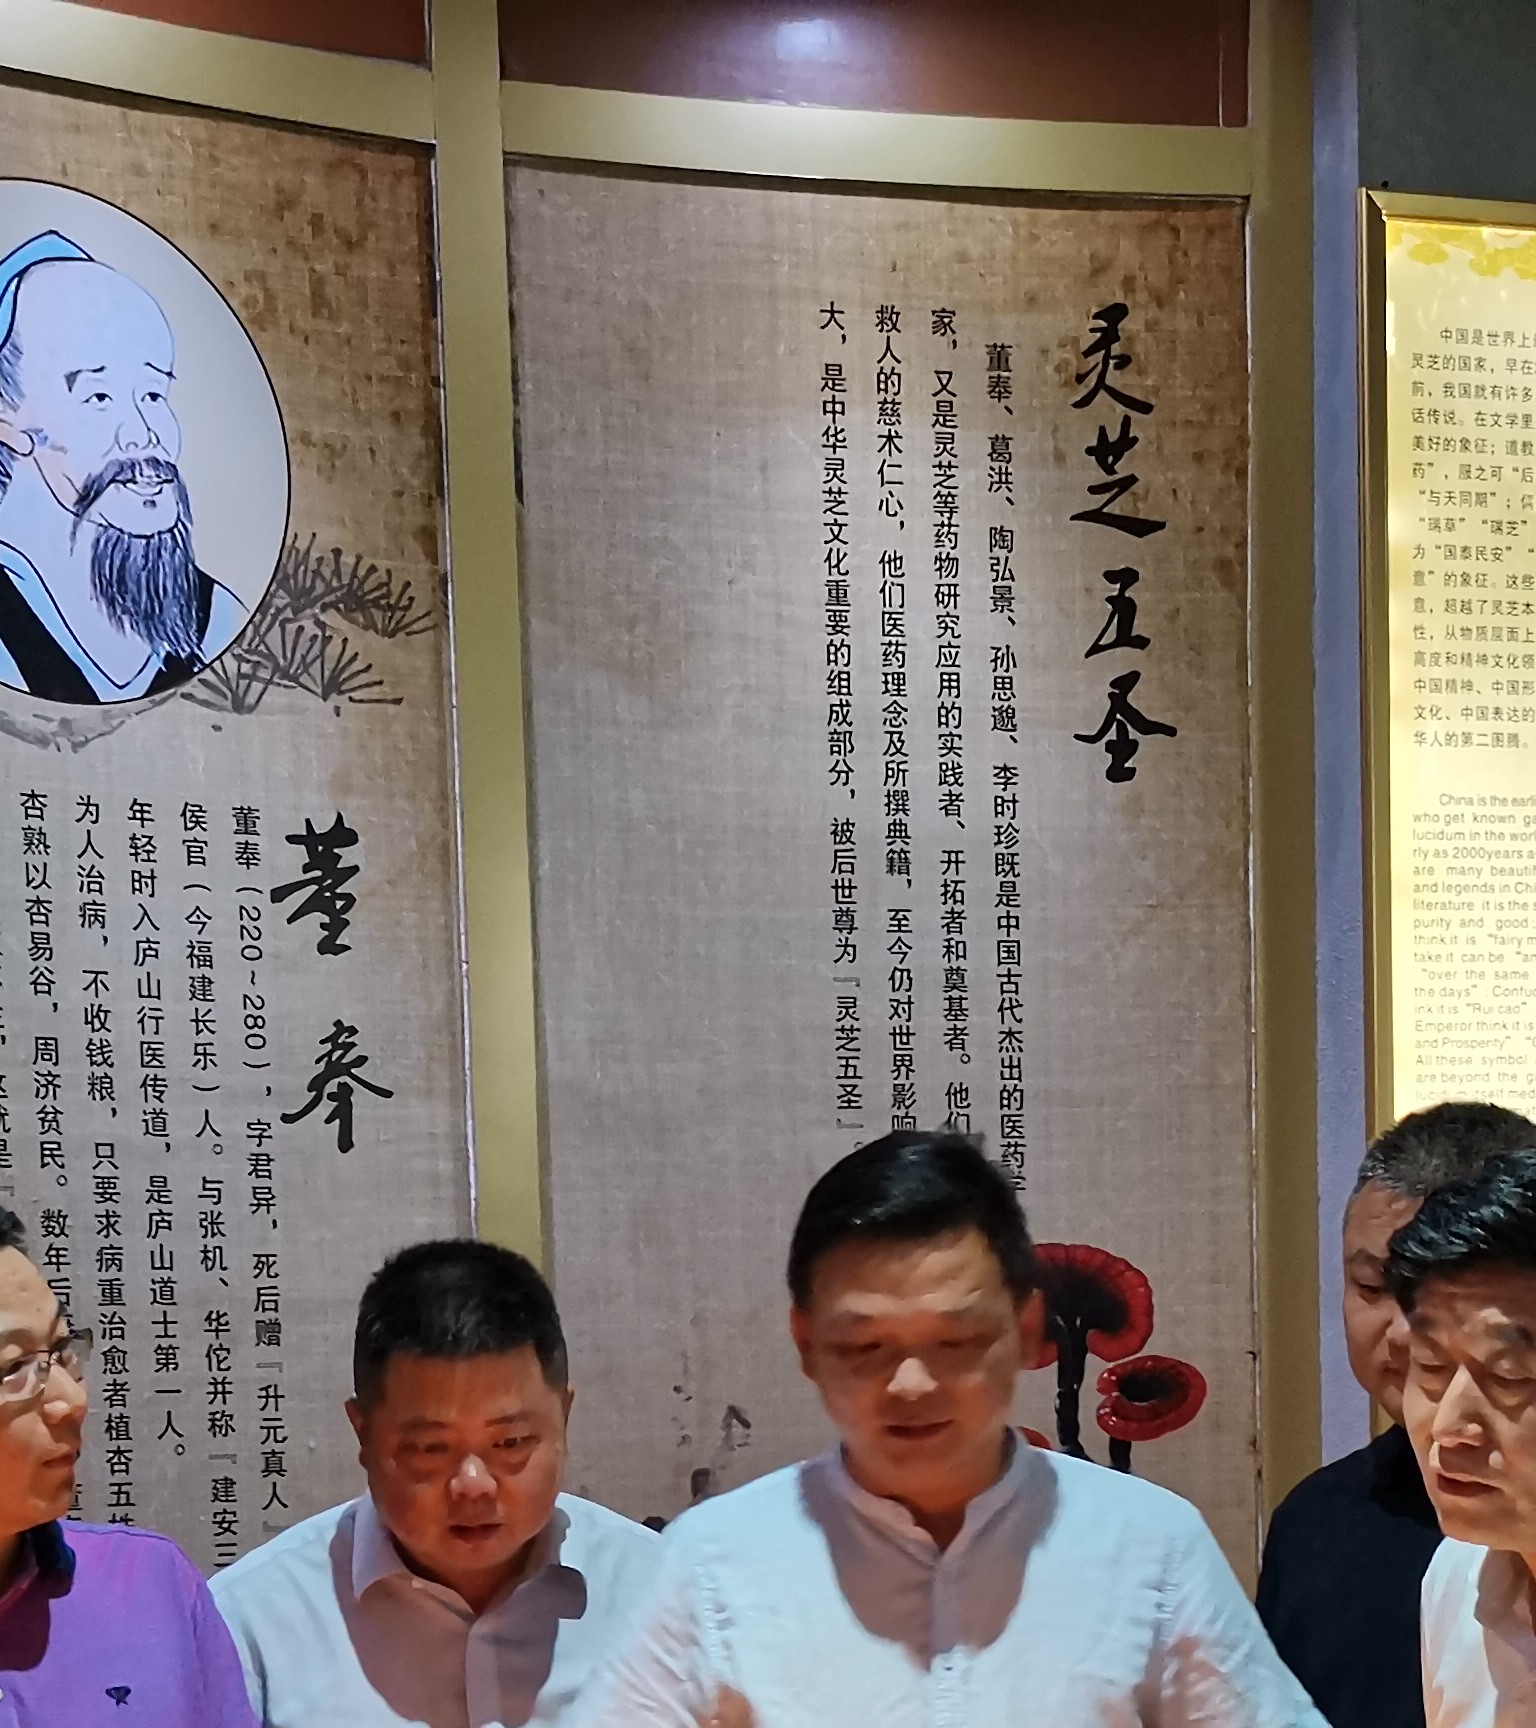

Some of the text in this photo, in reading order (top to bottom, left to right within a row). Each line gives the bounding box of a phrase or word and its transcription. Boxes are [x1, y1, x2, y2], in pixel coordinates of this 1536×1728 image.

[1439, 793, 1474, 807] China
[1477, 795, 1487, 807] is
[1490, 795, 1508, 807] the
[1413, 812, 1440, 823] who
[1444, 813, 1465, 826] get
[1473, 812, 1516, 824] known
[1413, 828, 1465, 841] lucidum
[1469, 829, 1480, 841] in
[1485, 830, 1506, 841] the
[1433, 850, 1448, 859] as
[1413, 866, 1435, 876] are
[1446, 866, 1483, 879] many
[1413, 882, 1438, 893] and
[1442, 882, 1495, 896] legends
[1499, 883, 1510, 893] in
[1494, 900, 1504, 911] is
[1508, 900, 1529, 912] the
[1414, 917, 1451, 931] purity
[1459, 917, 1484, 928] and
[1496, 917, 1528, 931] good
[1414, 934, 1445, 945] think
[1466, 935, 1476, 945] is
[1414, 952, 1442, 963] take
[1461, 954, 1484, 963] can
[1488, 952, 1504, 963] be
[1465, 969, 1486, 980] the
[1494, 971, 1529, 980] same
[269, 811, 394, 1155] 董奉
[1414, 986, 1435, 997] the
[1415, 1020, 1473, 1032] Emperor
[1477, 1020, 1508, 1031] think
[1436, 1055, 1473, 1065] these
[1441, 1072, 1490, 1085] beyond
[1498, 1072, 1518, 1082] the
